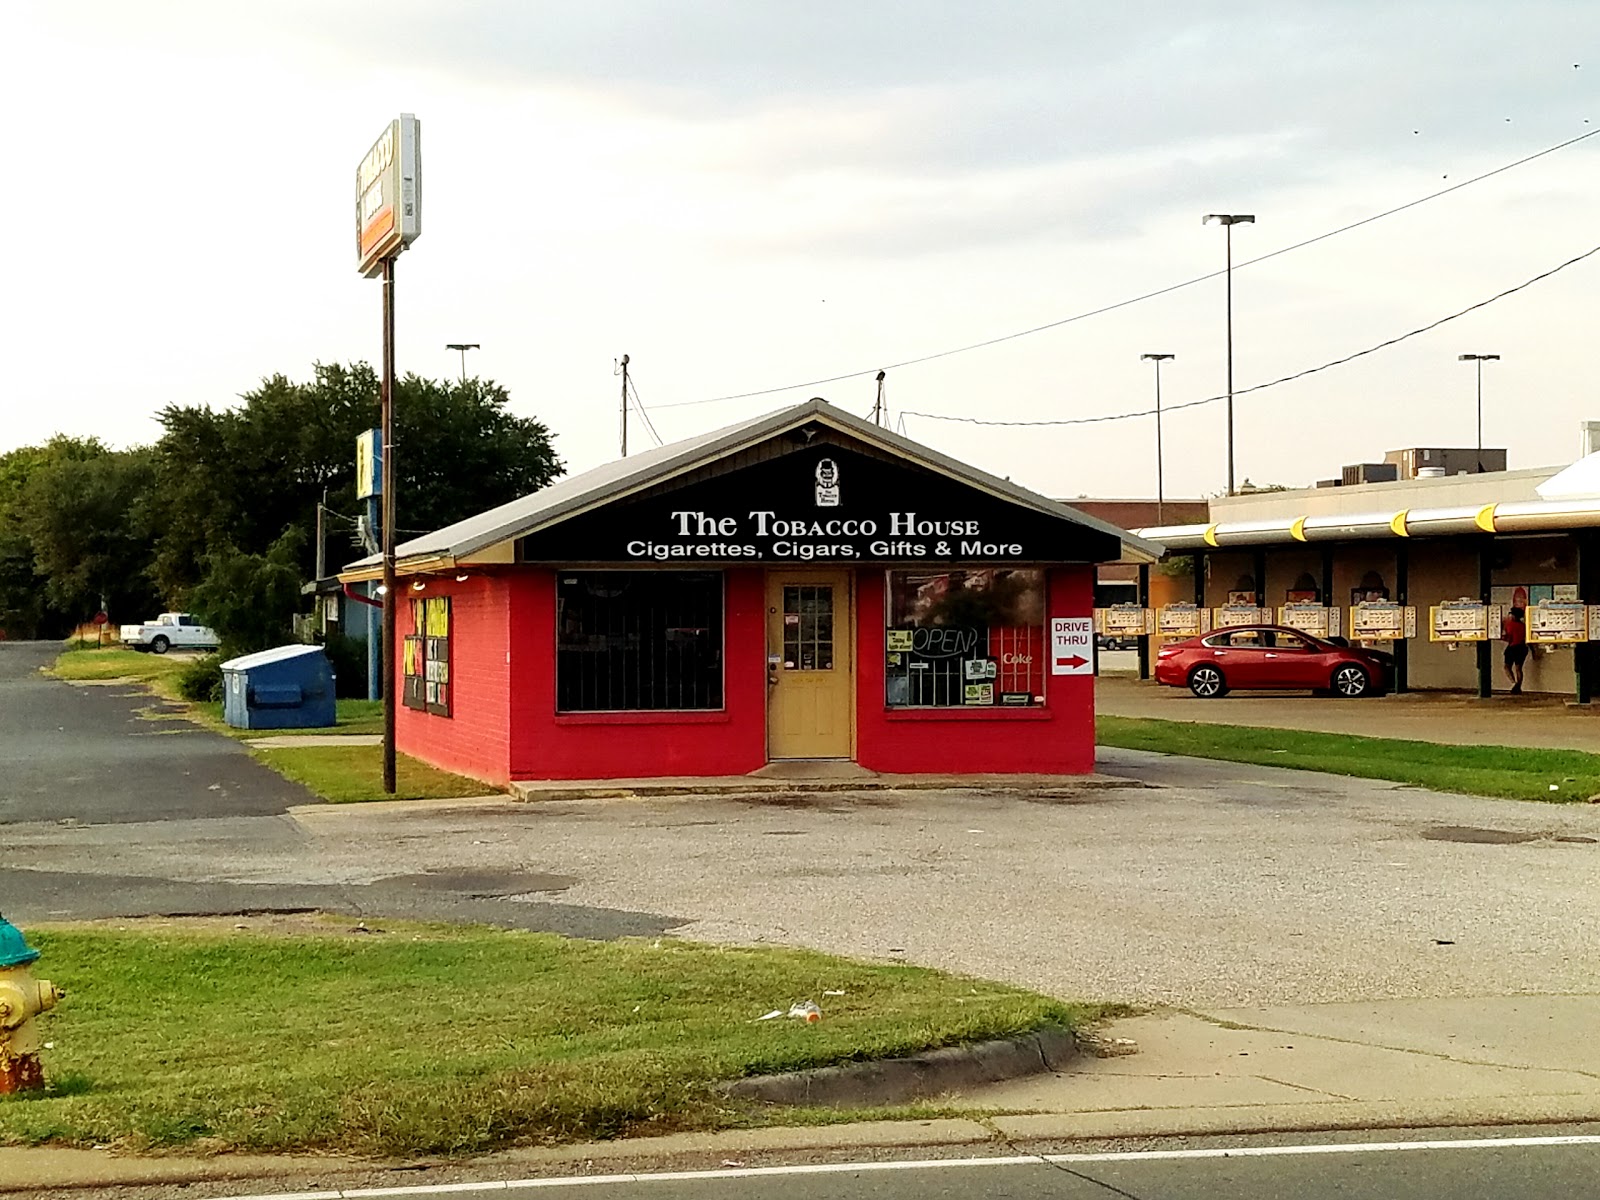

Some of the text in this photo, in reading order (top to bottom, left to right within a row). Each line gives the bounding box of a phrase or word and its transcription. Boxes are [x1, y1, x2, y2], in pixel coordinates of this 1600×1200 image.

[670, 511, 981, 537] The TOBACCO HOUSE
[626, 540, 1024, 560] Cigarettes, Cigars, Gifts & More
[1055, 622, 1089, 632] DRIVE
[913, 628, 972, 653] OPEN
[1056, 635, 1088, 645] THRU
[1003, 653, 1033, 665] Coke
